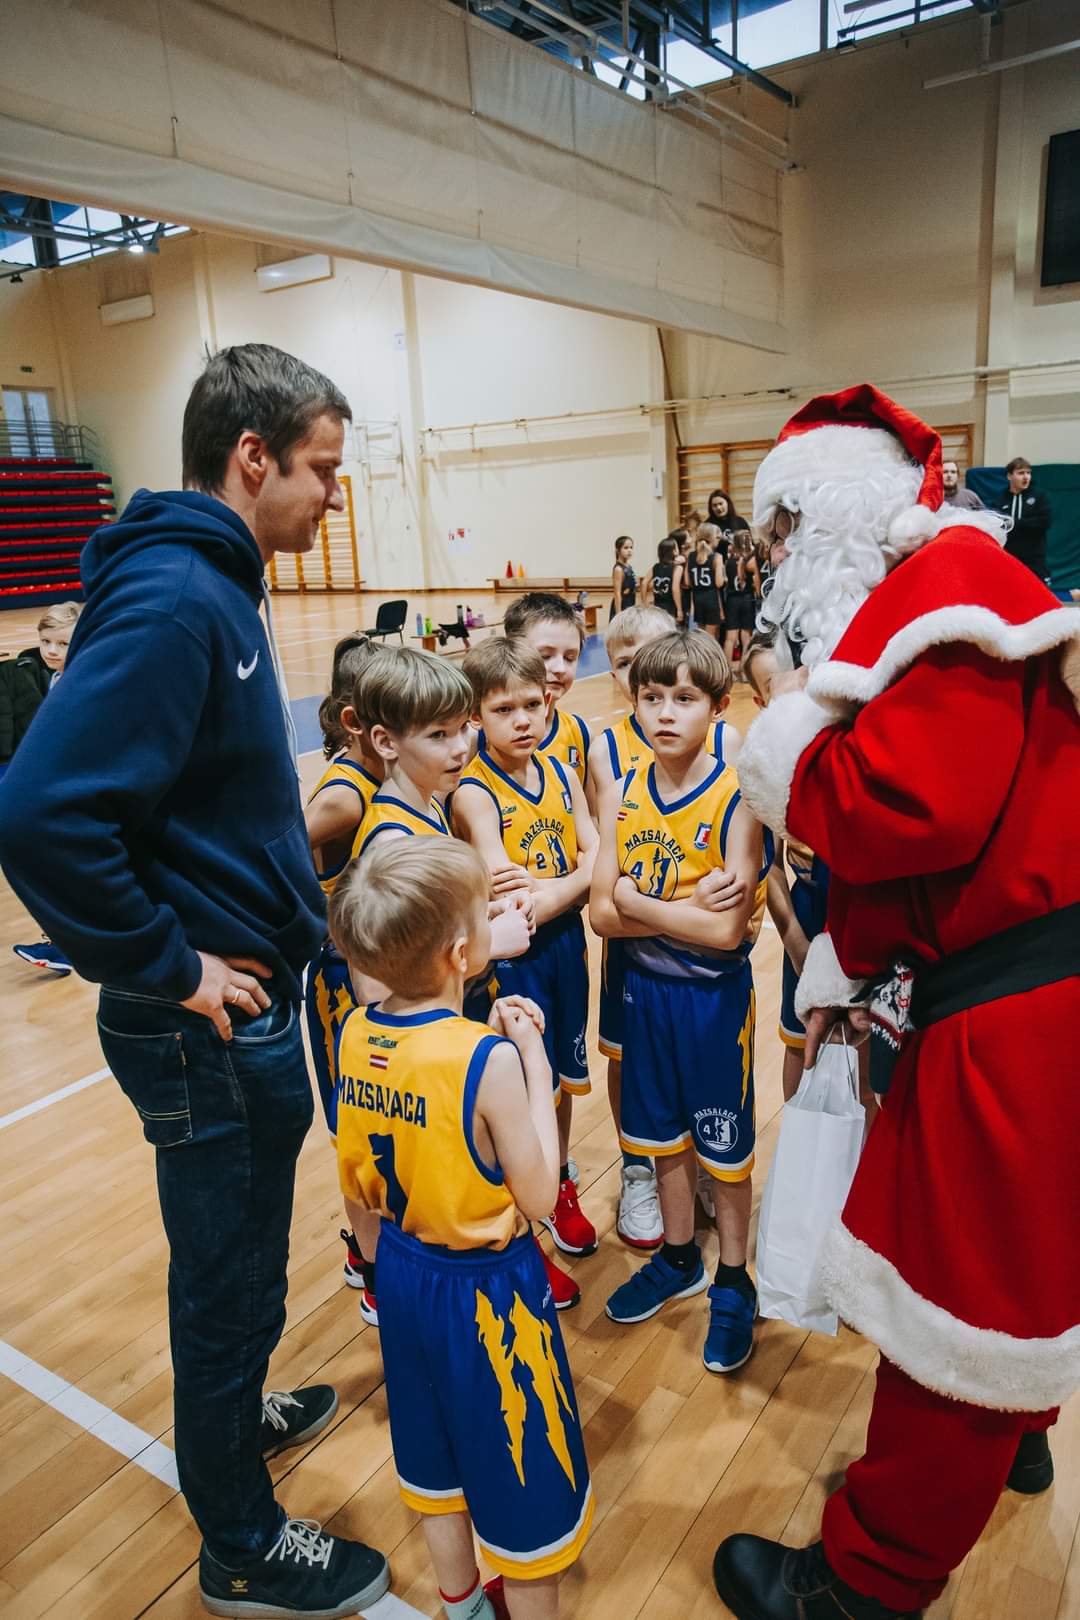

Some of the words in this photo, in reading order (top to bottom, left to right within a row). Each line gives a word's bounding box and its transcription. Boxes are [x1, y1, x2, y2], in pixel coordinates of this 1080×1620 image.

[691, 567, 711, 587] 15
[519, 817, 565, 851] MAZSALACA
[624, 829, 686, 863] MAZSALACA
[536, 852, 547, 870] 2
[630, 860, 643, 880] 4
[693, 1107, 738, 1121] MAZSALACA
[703, 1124, 711, 1136] 4
